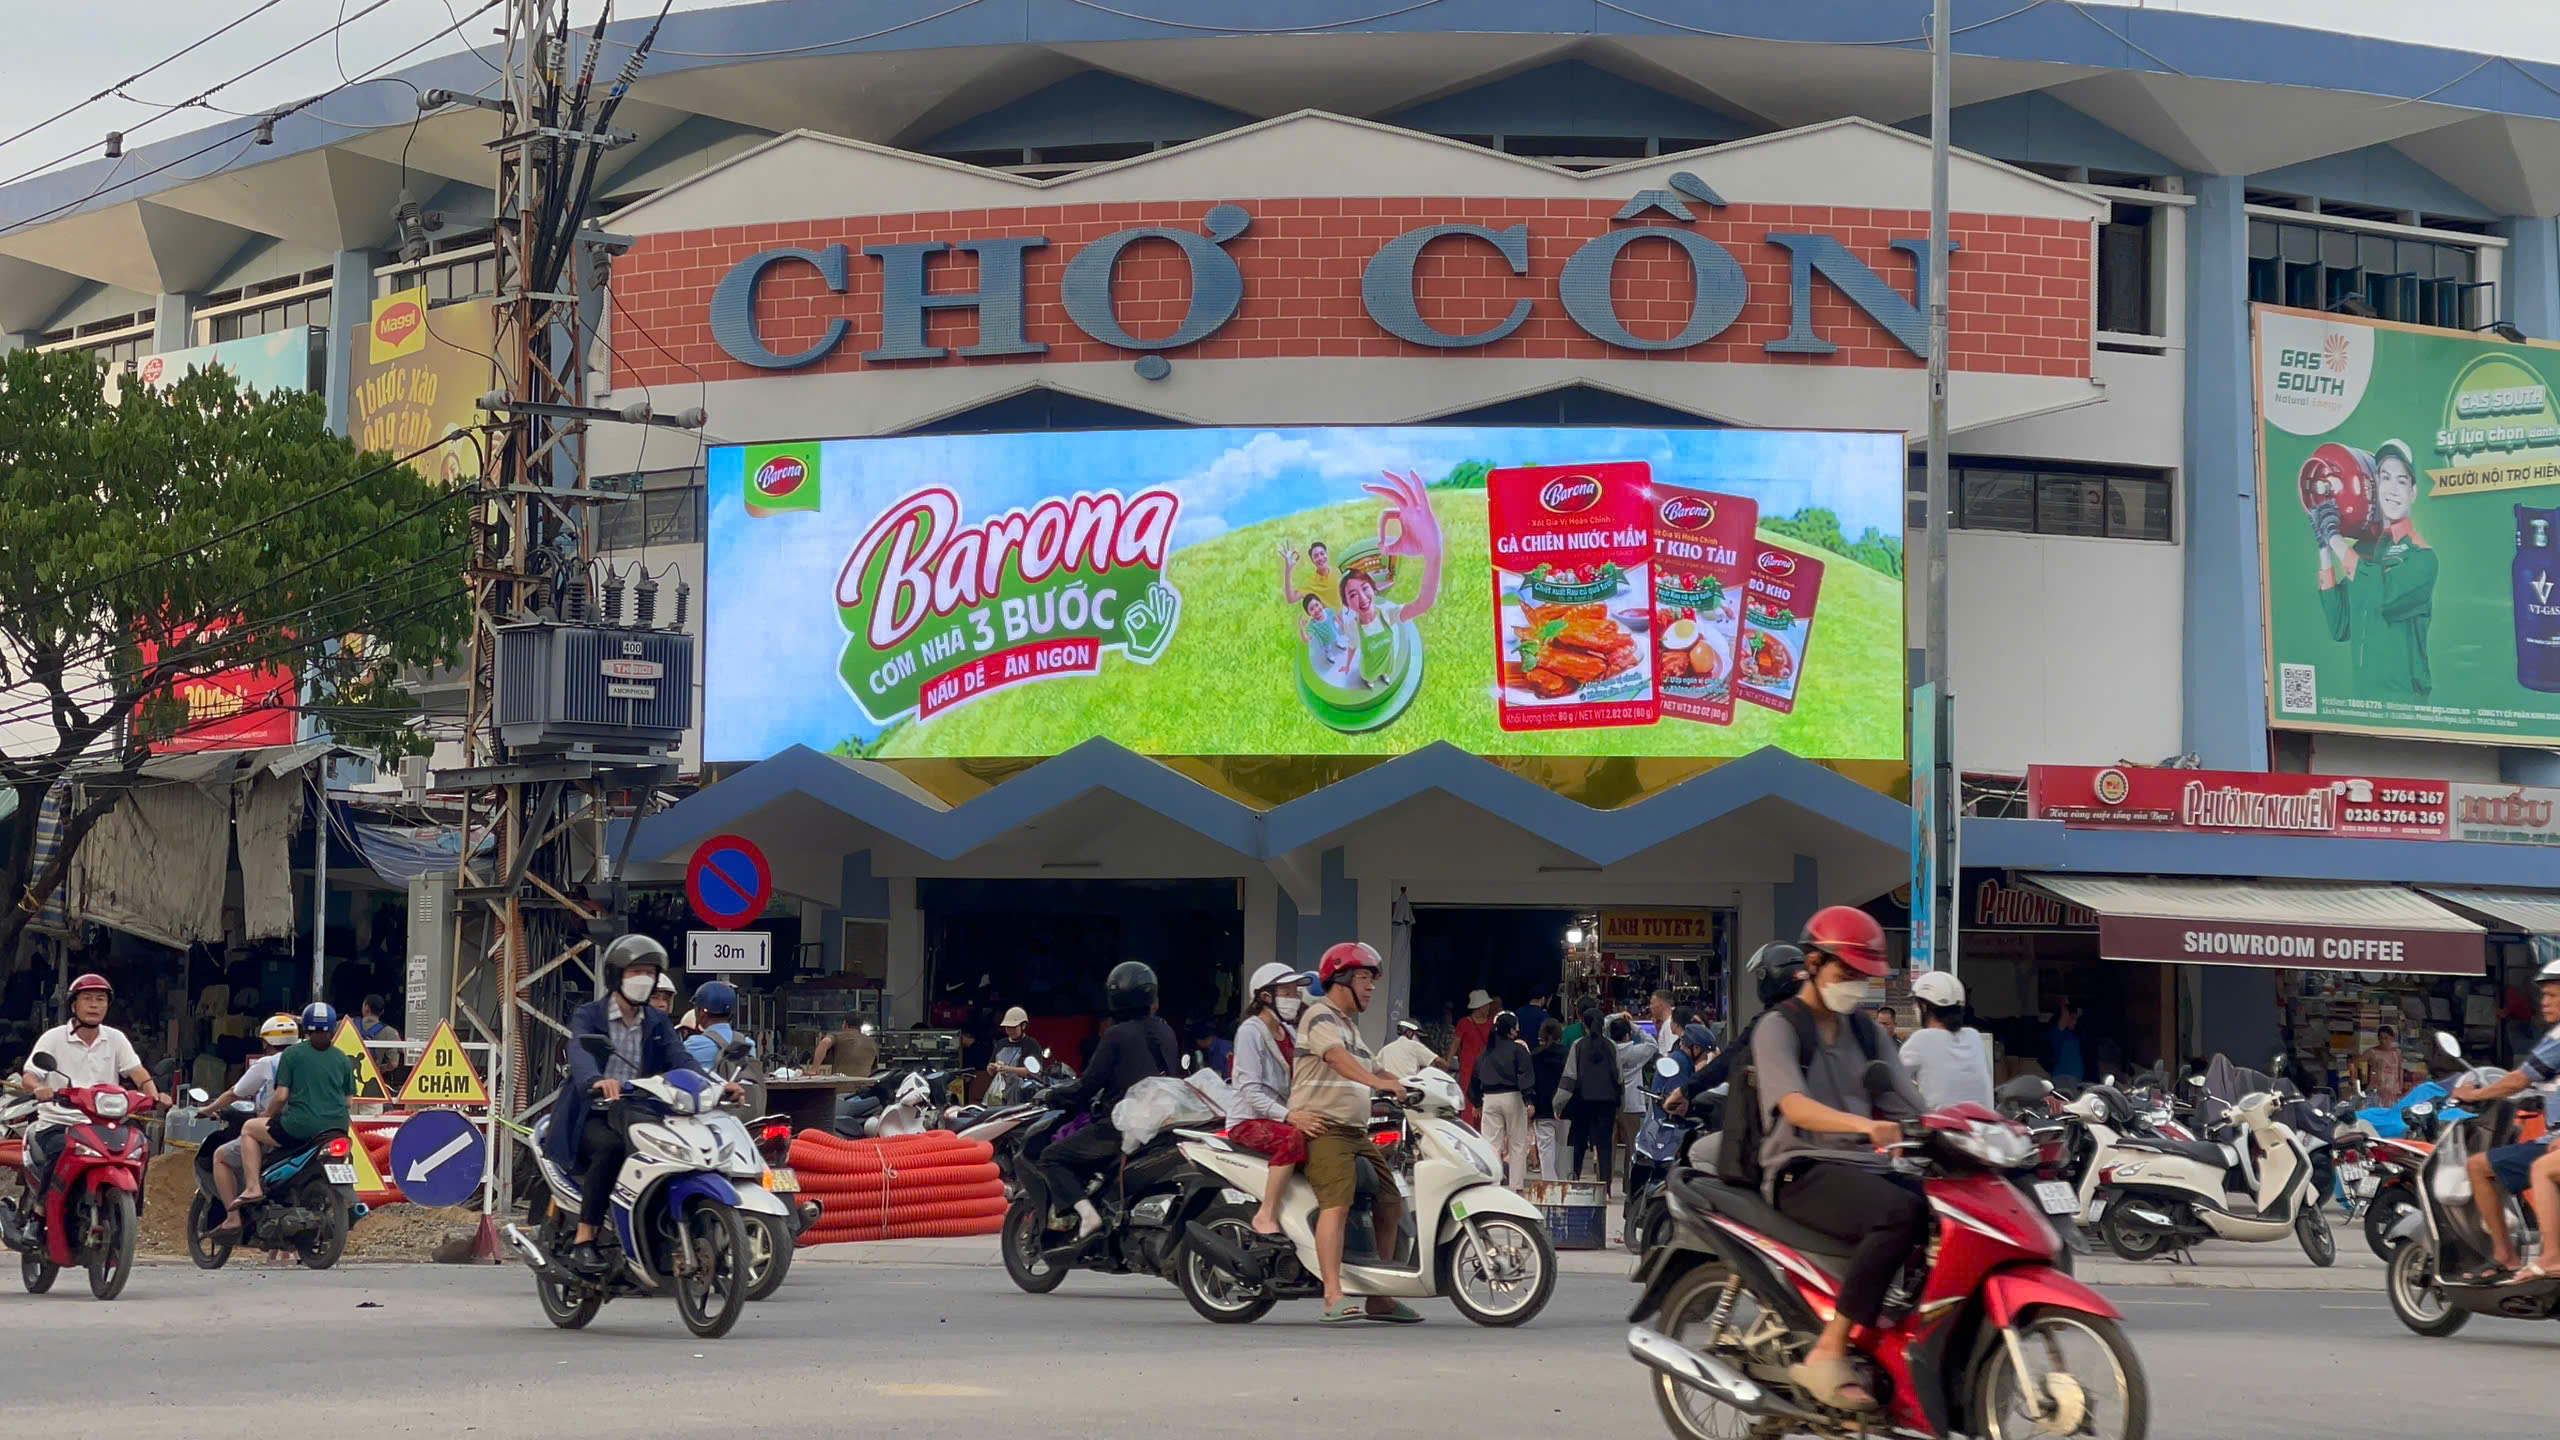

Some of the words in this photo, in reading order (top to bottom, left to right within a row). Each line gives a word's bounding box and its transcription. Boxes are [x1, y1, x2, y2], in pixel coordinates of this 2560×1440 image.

[710, 205, 1251, 379] CHỢ
[1362, 172, 1960, 358] CỒN
[381, 310, 416, 335] Maggi
[2280, 349, 2322, 369] GAS
[366, 363, 406, 415] bước
[408, 364, 438, 407] xào
[2277, 372, 2344, 396] SOUTH
[2274, 393, 2309, 406] Natural
[2457, 390, 2490, 409] GAS
[2494, 386, 2545, 407] SOUTH
[2460, 429, 2484, 447] lựa
[2487, 425, 2525, 447] chọn
[758, 465, 802, 488] Barona
[2439, 469, 2478, 487] NGƯỜI
[2482, 468, 2503, 487] NỘI
[2507, 463, 2531, 482] TRỢ
[1545, 483, 1595, 506] Barona
[1665, 501, 1709, 520] Barona
[1497, 533, 1521, 554] GÀ
[1521, 531, 1564, 552] CHIÊN
[1568, 528, 1609, 550] NƯỚC
[1613, 524, 1647, 547] MẮM
[1667, 541, 1702, 560] KHO
[1706, 545, 1737, 566] TÀU
[1761, 555, 1792, 569] Barona
[836, 487, 1179, 650] Barona
[1749, 576, 1765, 592] BÒ
[1766, 584, 1791, 600] KHO
[624, 643, 641, 653] 400
[869, 652, 916, 695] CƠM
[921, 625, 966, 668] NHÀ
[968, 608, 995, 651] 3
[1002, 580, 1117, 641] BƯỚC
[927, 679, 959, 710] NẤU
[965, 659, 985, 693] DỄ
[1004, 653, 1030, 679] ĂN
[1036, 644, 1090, 669] NGON
[1579, 711, 1592, 720] NET
[2183, 780, 2265, 827] PHƯƠNG
[2264, 787, 2337, 830] NGUYÊN
[2382, 789, 2416, 804] 3764
[2419, 790, 2445, 805] 367
[2345, 808, 2381, 822] 0236
[2383, 809, 2416, 823] 3764
[2419, 811, 2445, 825] 369
[714, 944, 745, 958] 30m
[2184, 931, 2315, 958] SHOWROOM
[2323, 937, 2404, 962] COFFEE
[435, 1049, 453, 1067] ĐI
[418, 1071, 469, 1097] CHẬM
